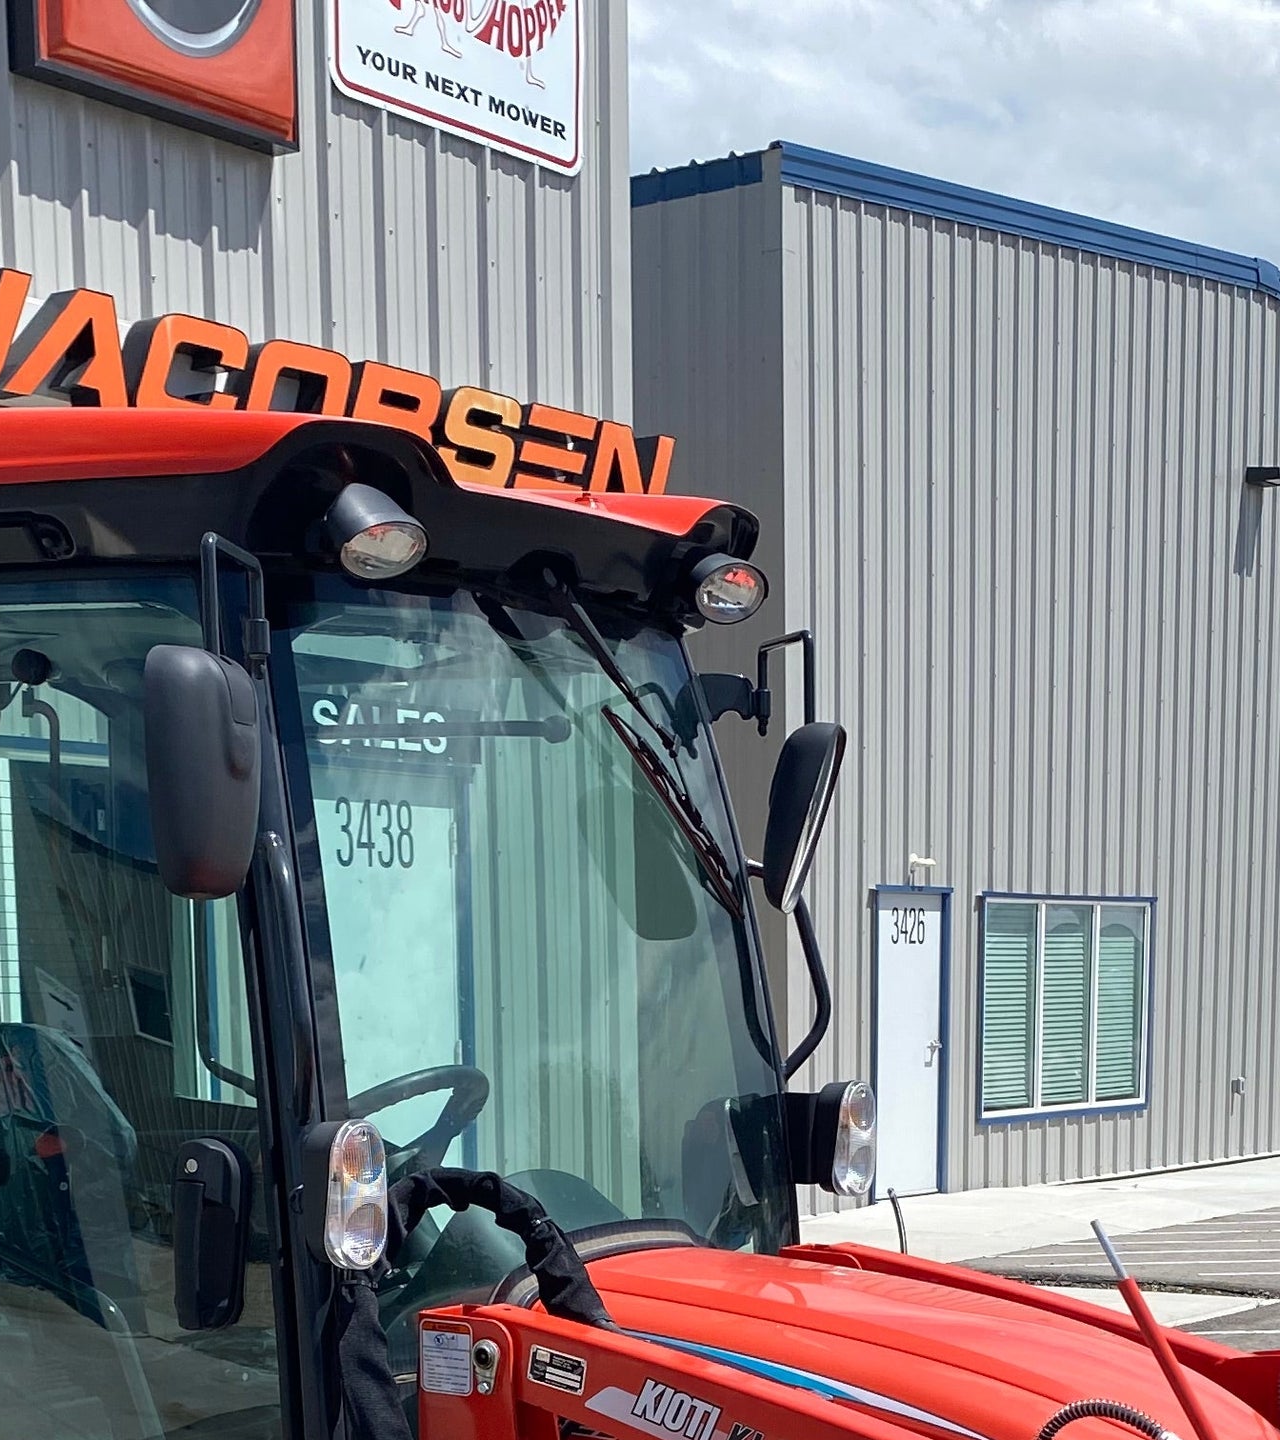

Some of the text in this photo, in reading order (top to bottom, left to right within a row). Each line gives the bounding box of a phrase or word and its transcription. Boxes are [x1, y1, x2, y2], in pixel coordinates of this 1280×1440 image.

[356, 45, 567, 140] YOUR NEXT MOWER
[312, 699, 447, 754] SALES
[335, 796, 414, 869] 3438
[891, 907, 925, 945] 3426
